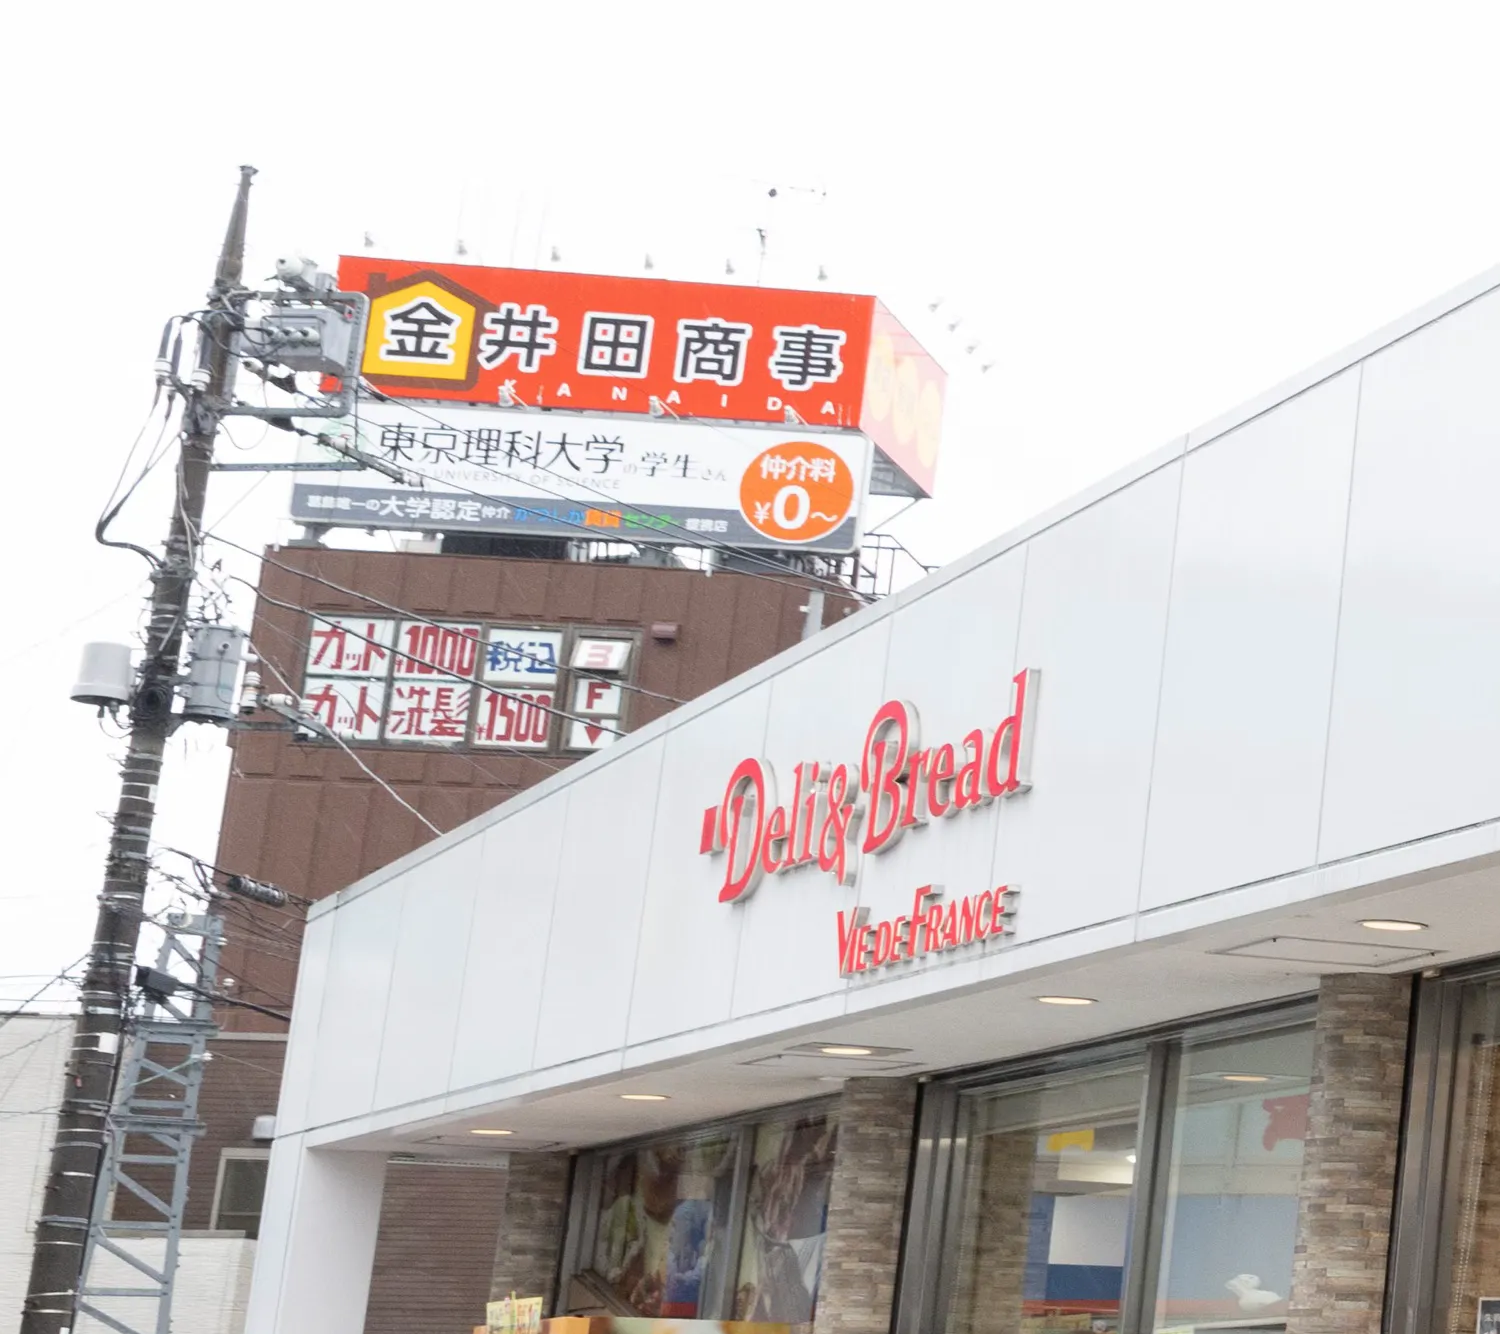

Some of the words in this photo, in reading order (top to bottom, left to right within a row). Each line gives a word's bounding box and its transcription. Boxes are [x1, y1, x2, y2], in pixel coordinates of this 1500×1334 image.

[382, 296, 846, 391] 金井田商事
[503, 378, 837, 416] KANAIDA
[760, 454, 836, 483] 仲介料
[311, 621, 386, 671] カット
[395, 624, 479, 677] ¥1000
[486, 639, 557, 673] 税込
[305, 684, 379, 734] カット
[390, 686, 470, 738] 洗髪
[477, 692, 551, 743] ¥1500
[719, 757, 821, 903] Deli
[818, 763, 857, 886] &
[860, 667, 1032, 855] Bread
[837, 906, 872, 977] VIE
[873, 915, 907, 967] DE
[908, 884, 1012, 958] FRANCE
